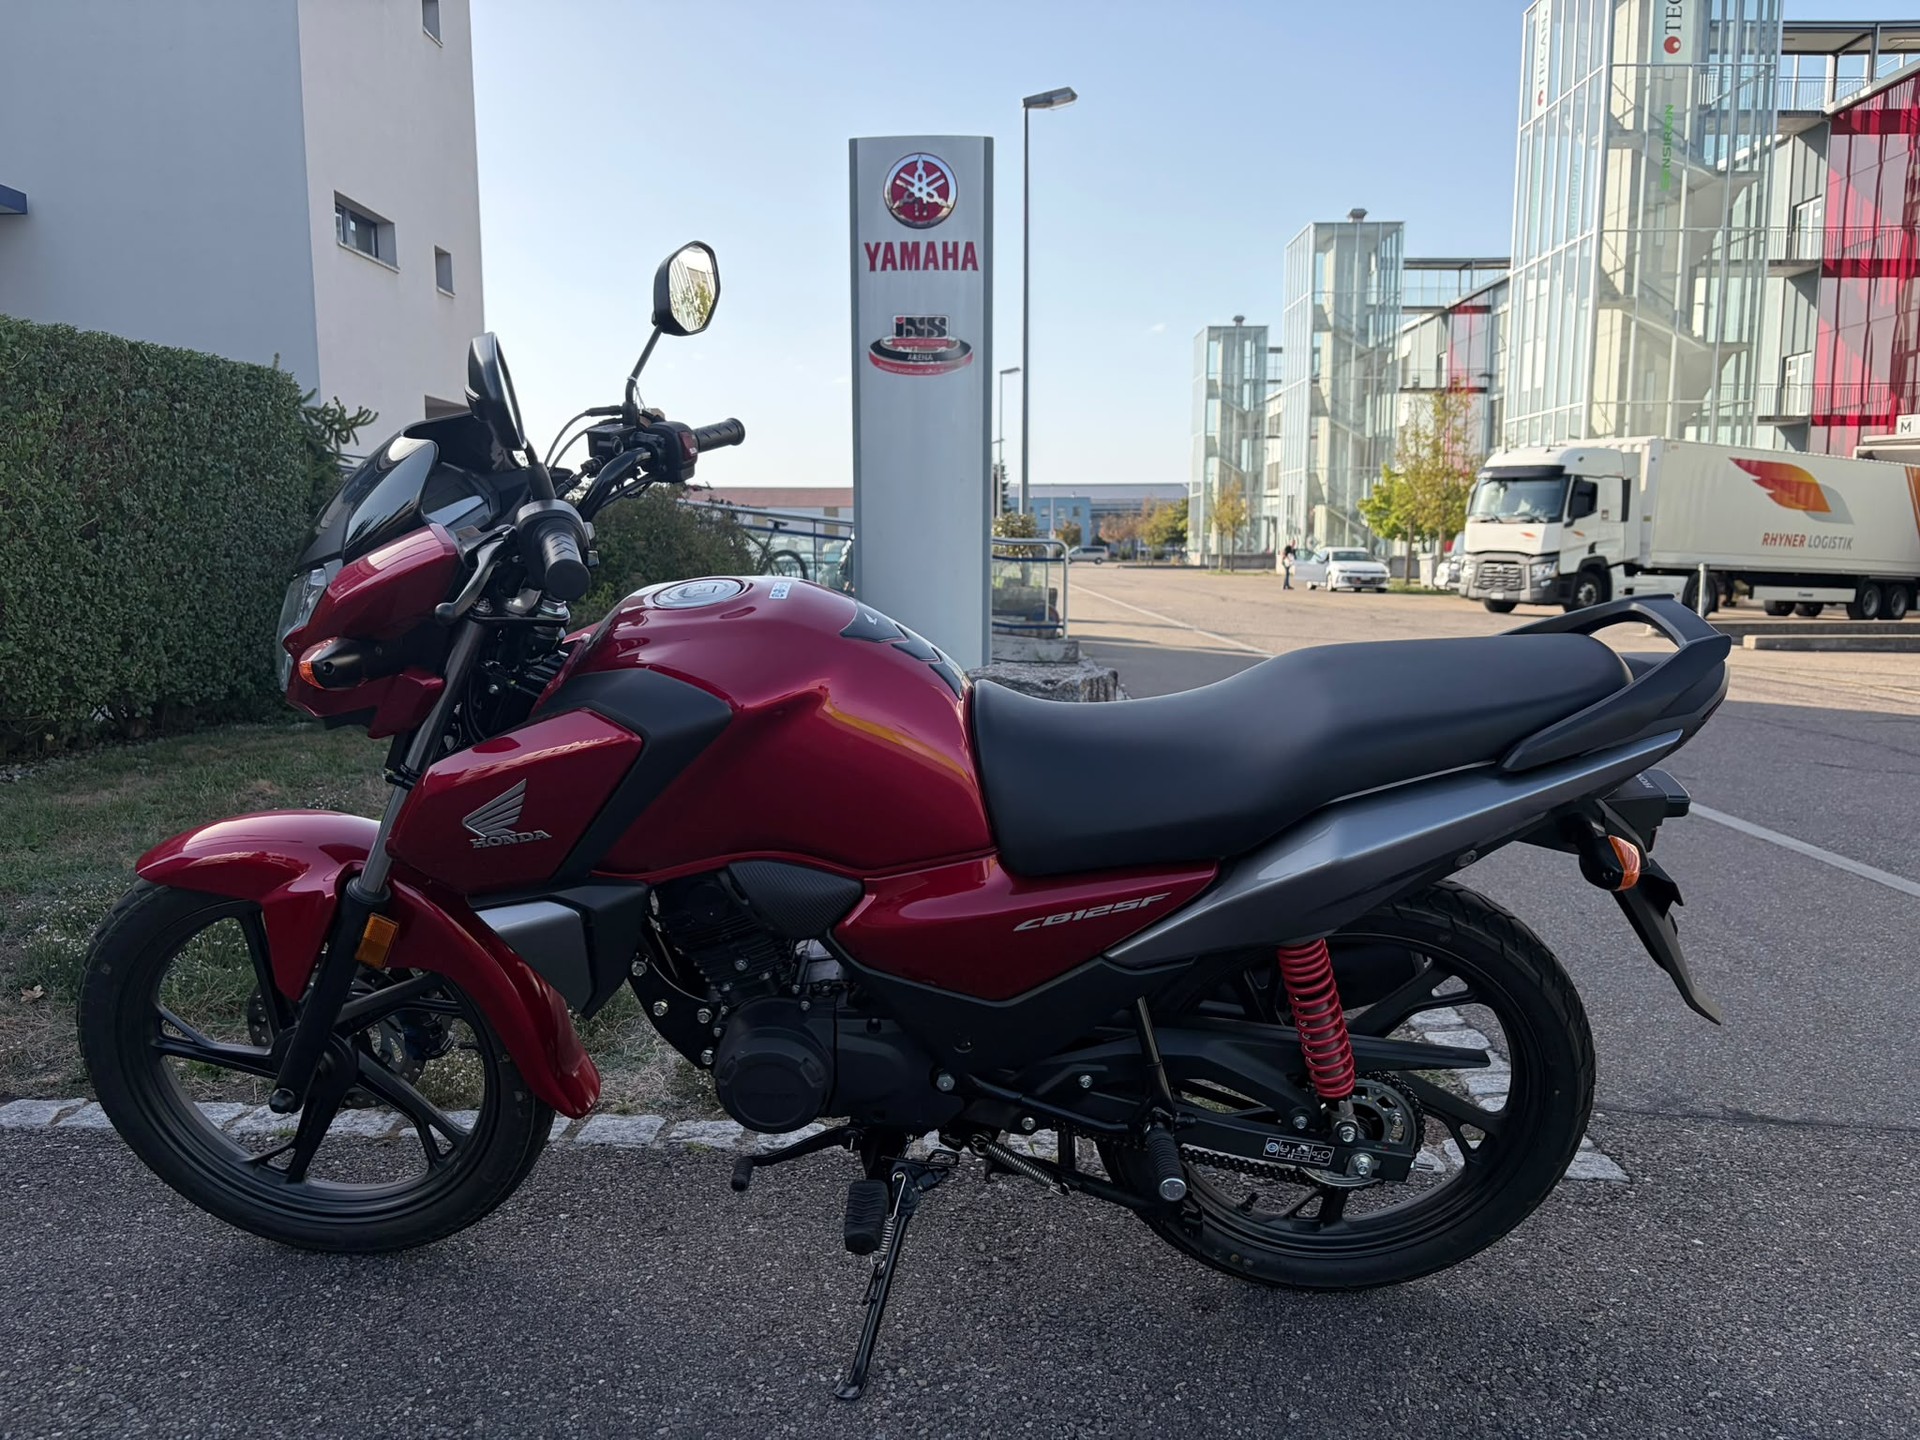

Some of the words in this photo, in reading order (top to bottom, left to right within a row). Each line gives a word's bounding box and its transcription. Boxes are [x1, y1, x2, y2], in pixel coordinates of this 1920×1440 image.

[1664, 0, 1682, 35] TE
[863, 241, 979, 272] YAMAHA
[1761, 532, 1806, 548] RHYNER
[1807, 534, 1854, 550] LOGISTIK
[469, 829, 552, 848] HONDA
[1013, 891, 1172, 932] CB125SF
